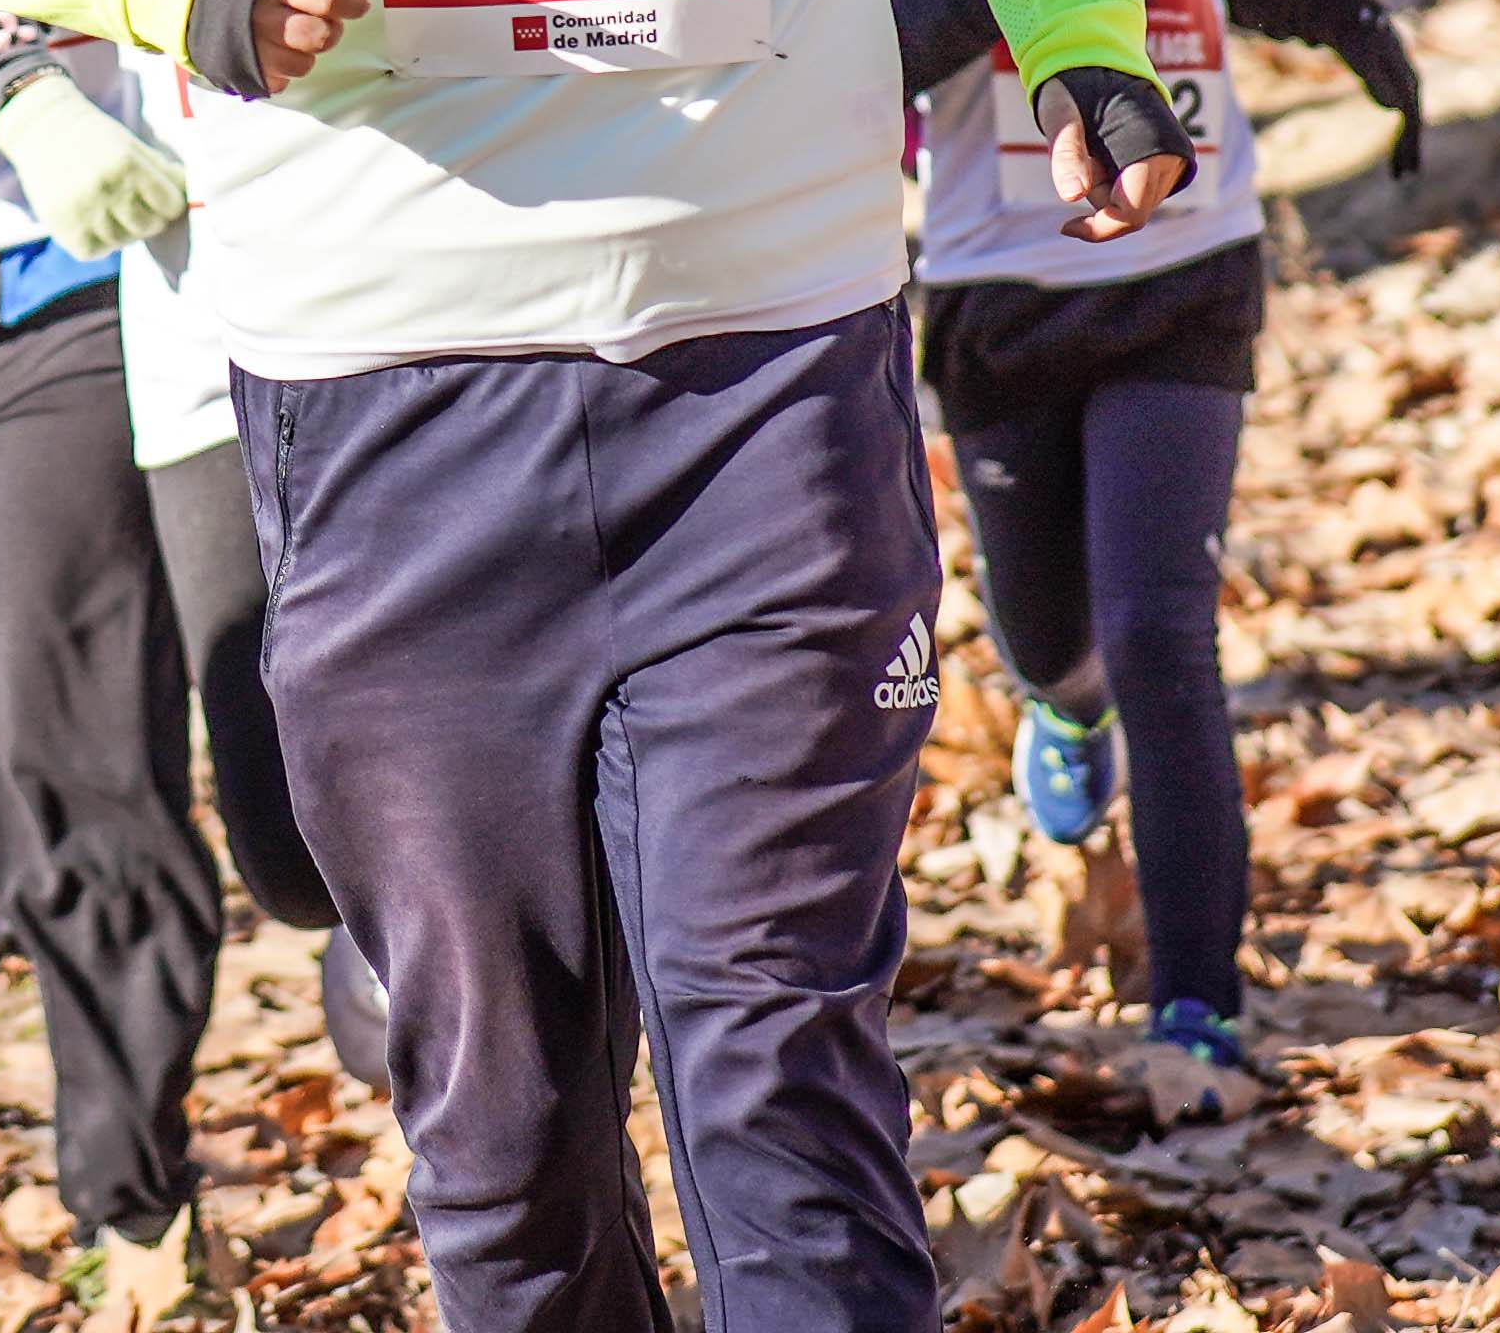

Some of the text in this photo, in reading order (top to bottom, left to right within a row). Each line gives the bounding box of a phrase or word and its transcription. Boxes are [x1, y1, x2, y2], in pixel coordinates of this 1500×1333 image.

[552, 10, 657, 29] Comunidad
[553, 29, 658, 49] de Madrid
[873, 675, 940, 710] adidas
